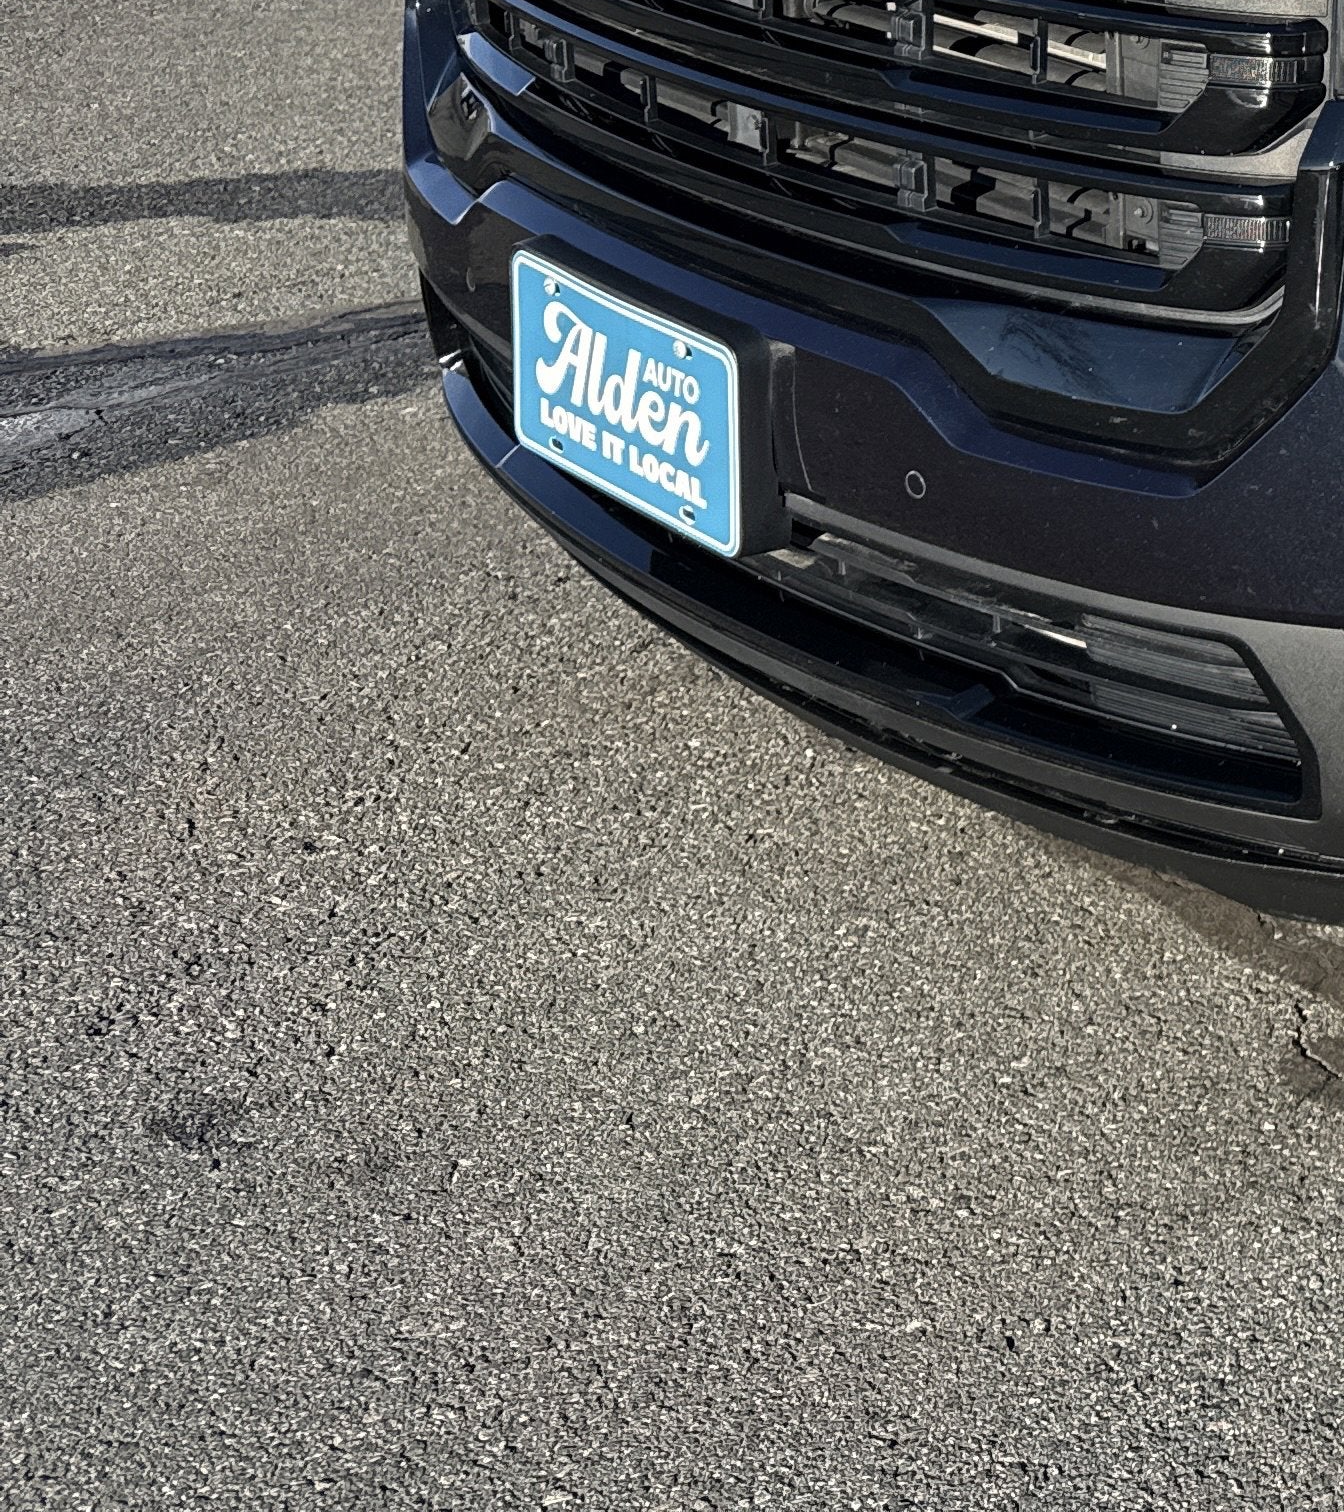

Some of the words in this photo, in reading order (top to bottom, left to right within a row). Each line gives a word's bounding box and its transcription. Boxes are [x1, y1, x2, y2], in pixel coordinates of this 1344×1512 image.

[535, 301, 711, 468] Alden
[643, 357, 701, 406] AUTO
[539, 397, 598, 452] LOVE
[602, 430, 627, 466] IT
[629, 444, 709, 510] LOCAL
